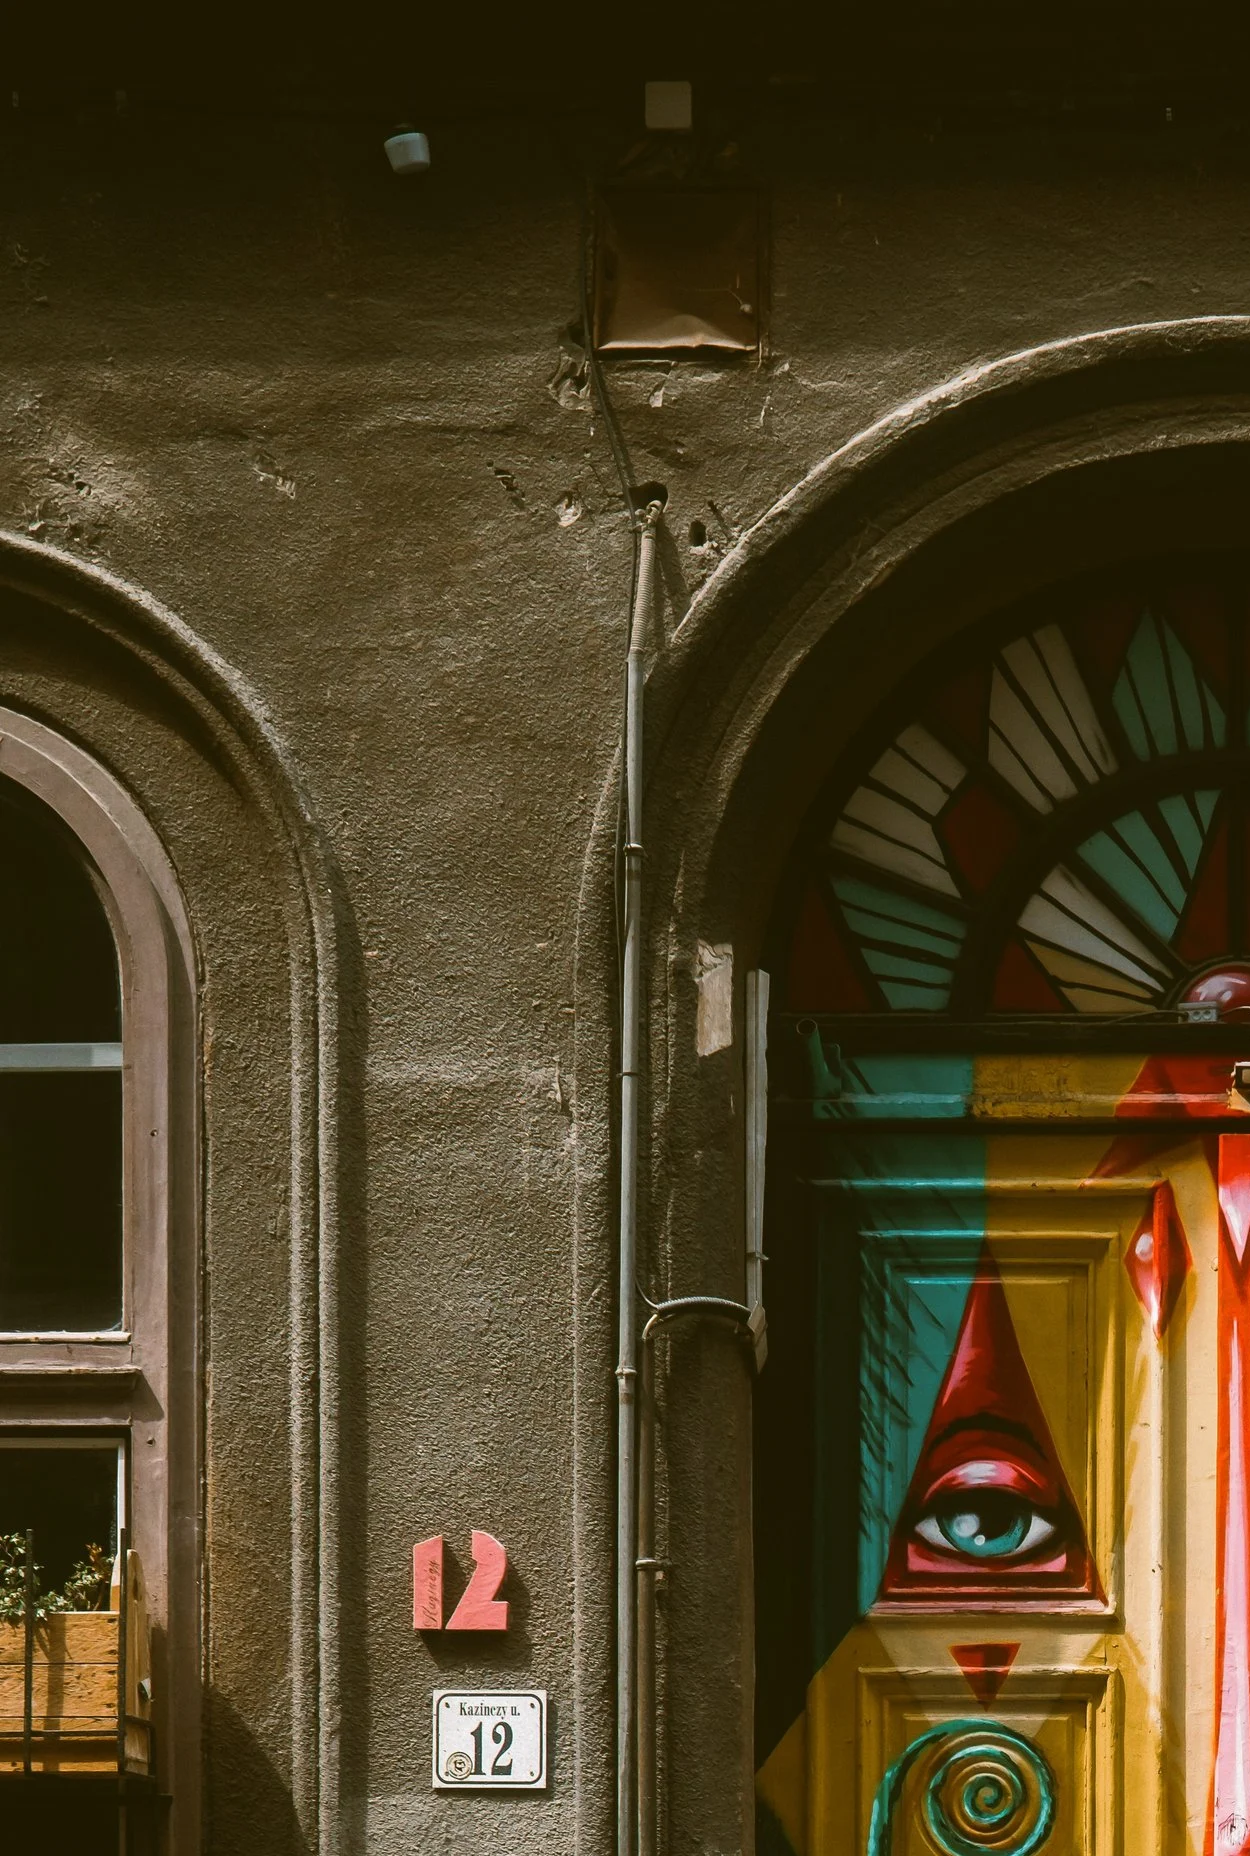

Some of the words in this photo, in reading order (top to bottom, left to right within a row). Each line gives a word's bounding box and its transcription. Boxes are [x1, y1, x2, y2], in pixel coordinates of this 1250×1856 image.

[412, 1530, 509, 1631] 12
[459, 1701, 508, 1719] Kazinczy
[511, 1704, 521, 1717] u.
[470, 1721, 513, 1776] 12
